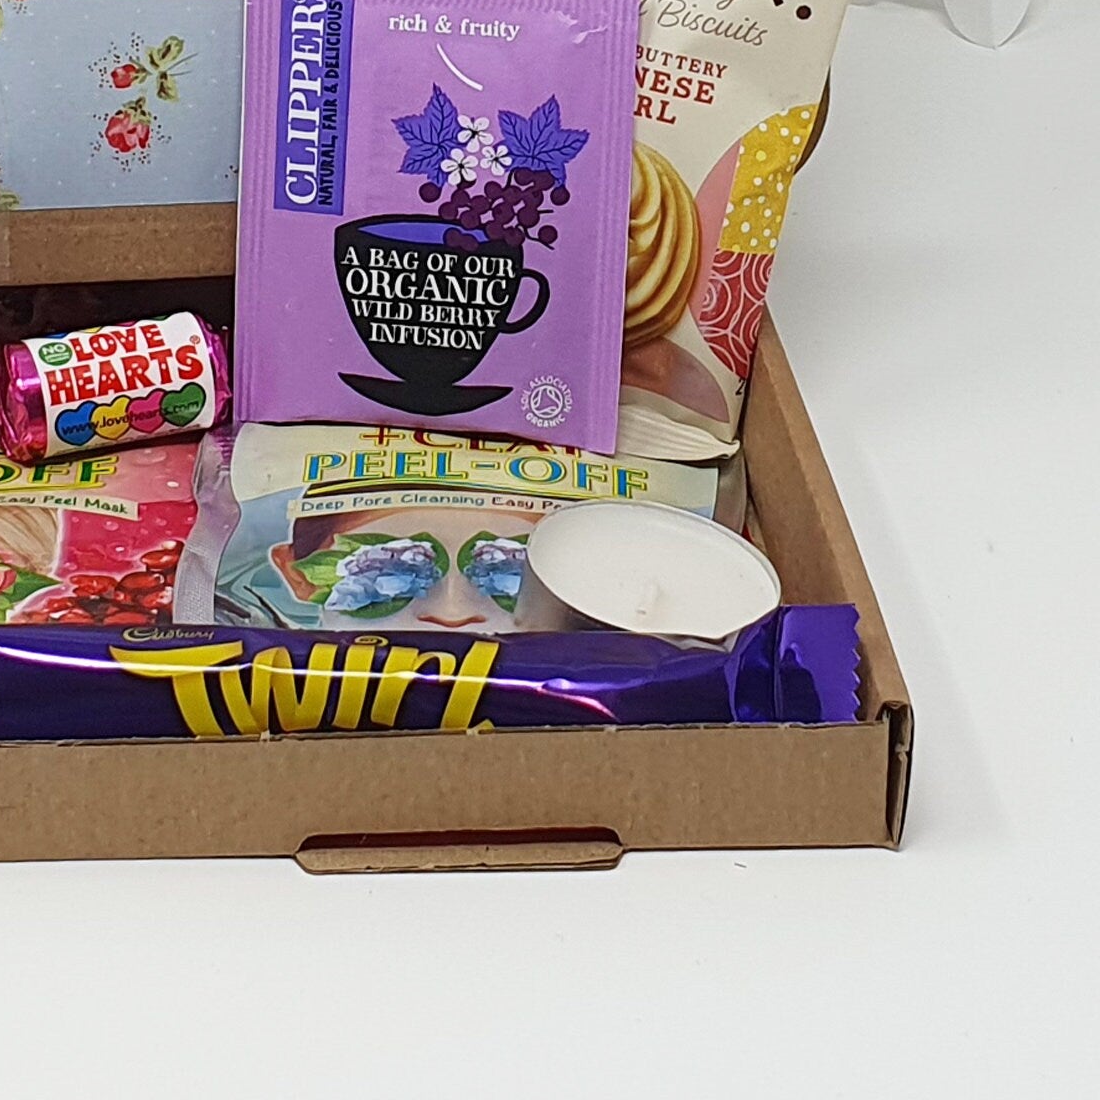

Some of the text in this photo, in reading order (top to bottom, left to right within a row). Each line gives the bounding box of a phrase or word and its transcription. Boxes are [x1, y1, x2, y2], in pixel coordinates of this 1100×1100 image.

[388, 15, 520, 41] rich & fruity
[324, 83, 338, 94] &
[322, 98, 337, 130] FAIR
[318, 135, 338, 206] NATURAL,
[340, 246, 516, 279] A BAG OF OUR
[345, 267, 510, 306] ORGANIC
[352, 299, 501, 328] WILD BERRY
[42, 343, 67, 356] NO
[68, 324, 166, 363] LOVE
[368, 321, 486, 351] INFUSION
[43, 344, 204, 407] HEARTS
[302, 451, 649, 499] PEEL-OFF
[42, 495, 77, 507] Peel
[84, 498, 129, 515] Mask
[300, 500, 345, 513] Deep
[352, 496, 393, 507] Pore
[400, 493, 486, 507] Cleansing
[491, 497, 534, 509] Easy
[122, 627, 215, 642] Cadbury
[109, 635, 500, 740] Twirl
